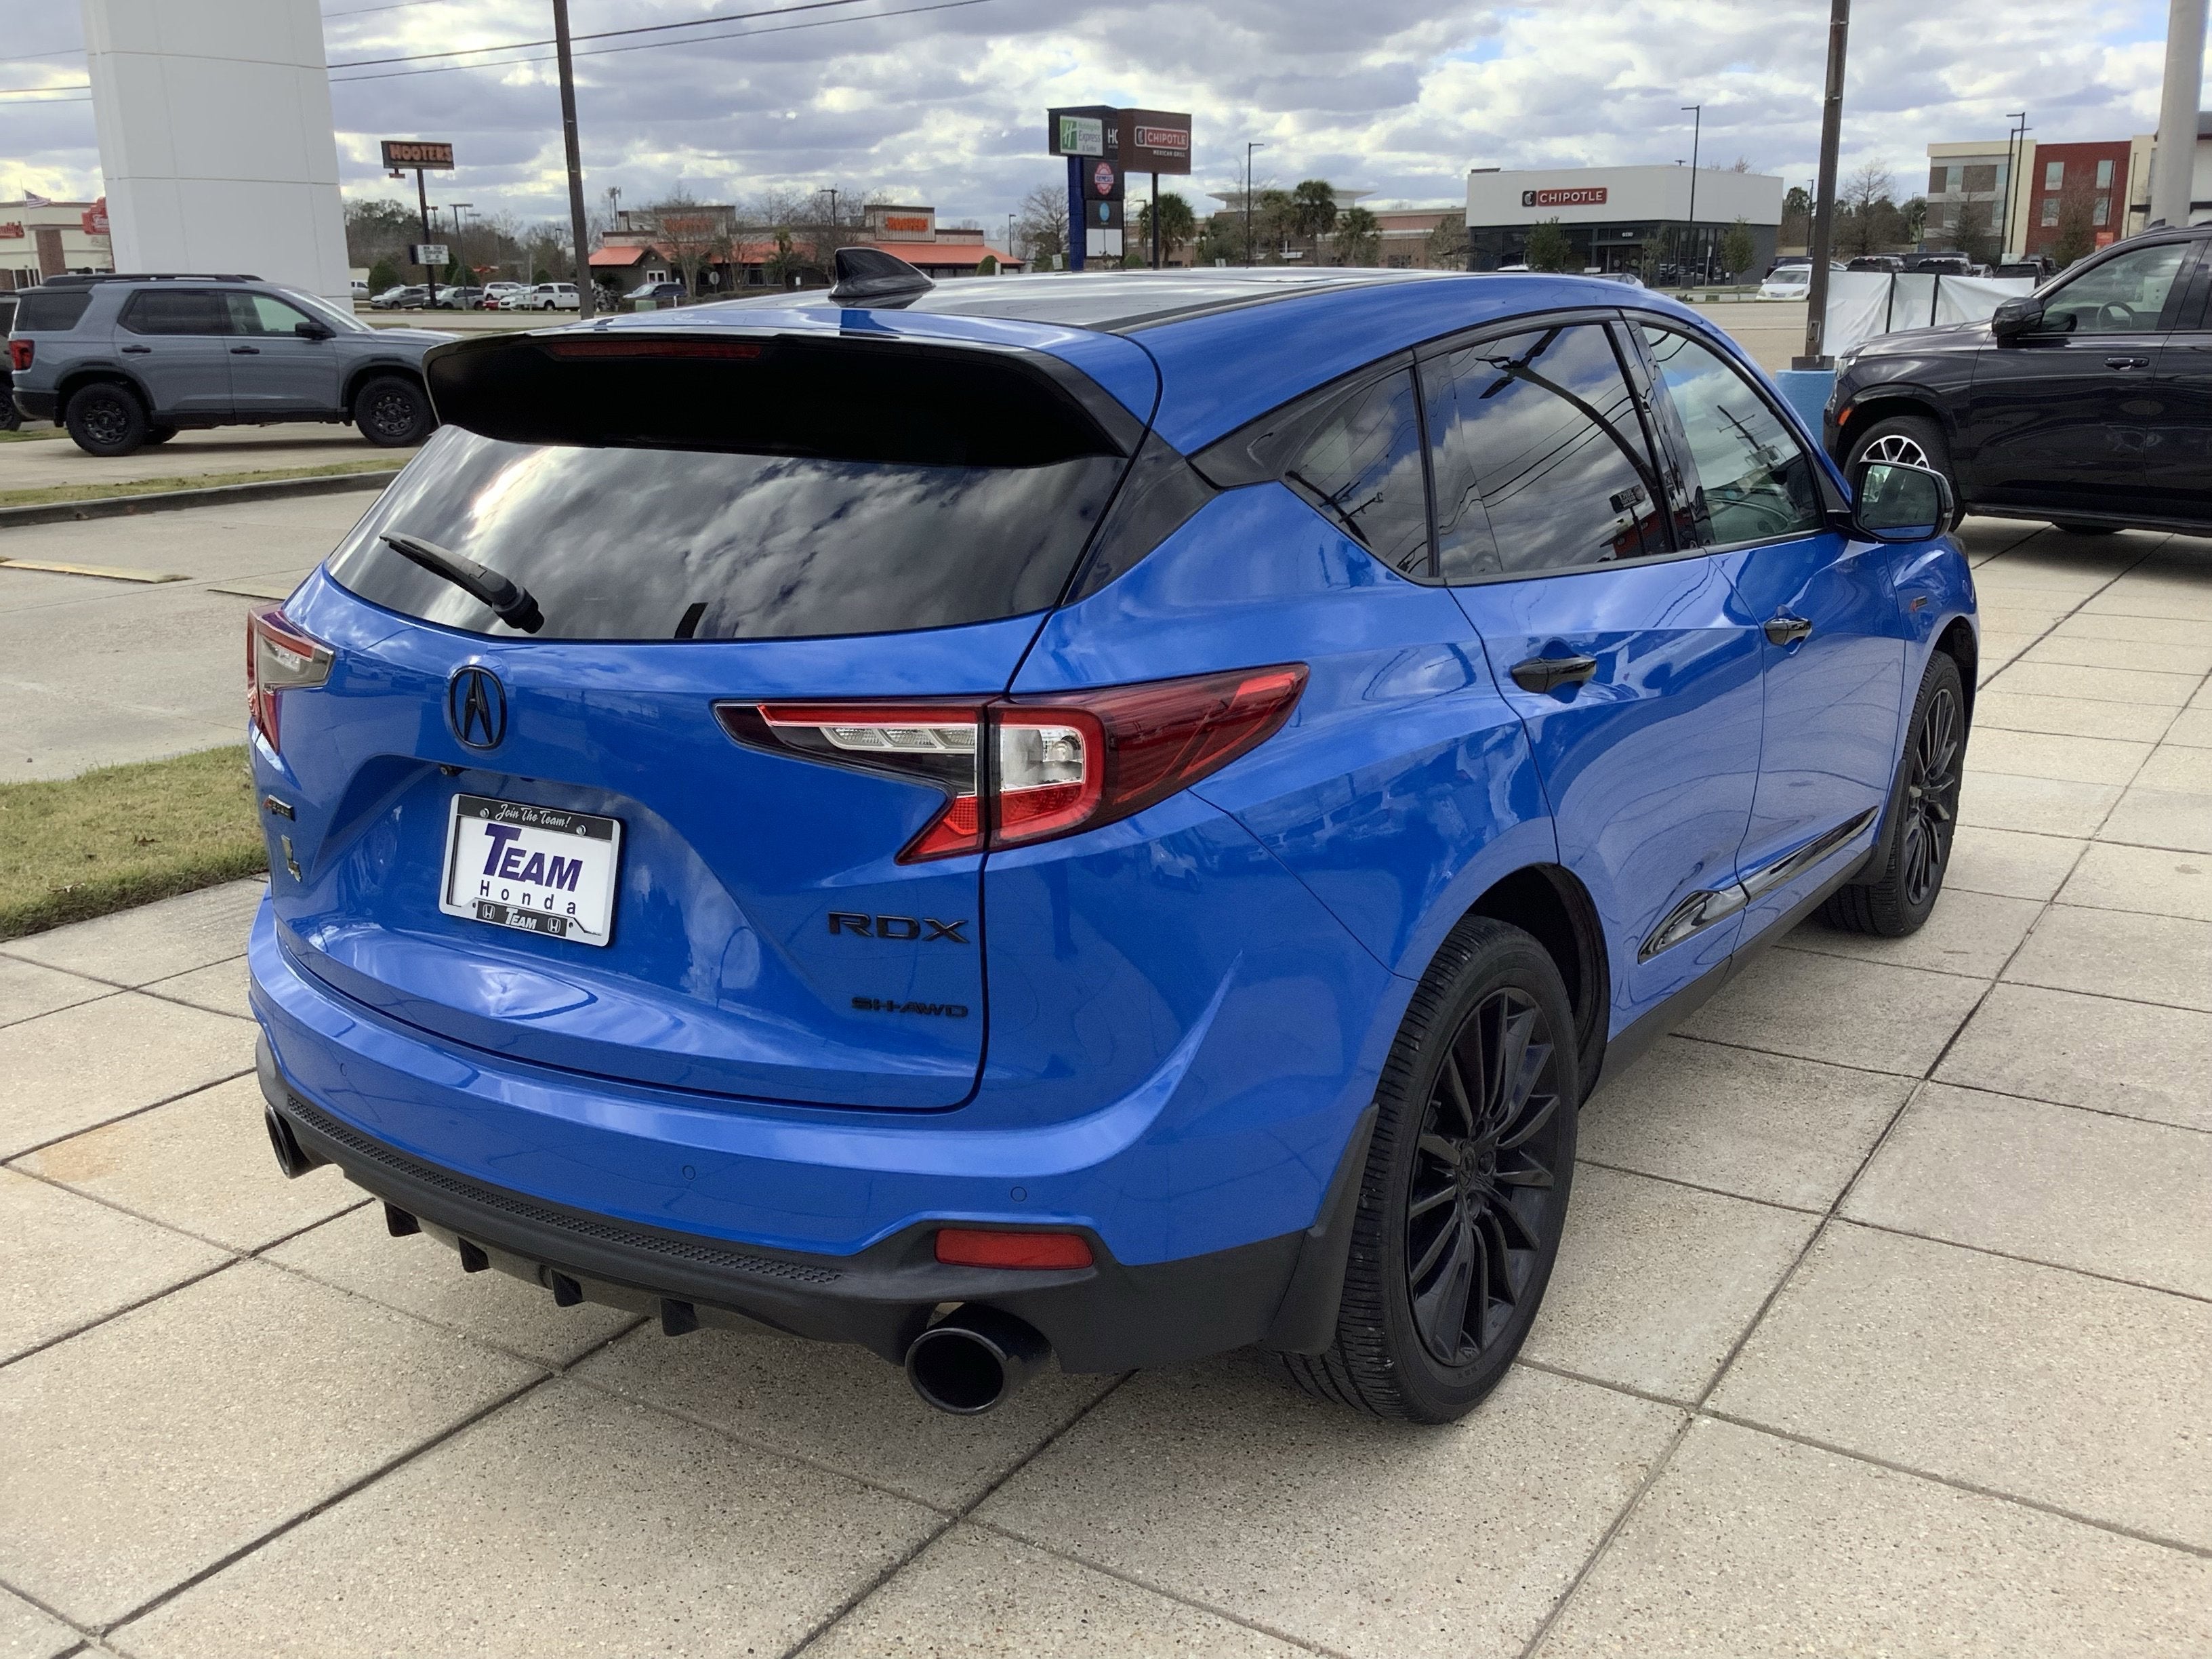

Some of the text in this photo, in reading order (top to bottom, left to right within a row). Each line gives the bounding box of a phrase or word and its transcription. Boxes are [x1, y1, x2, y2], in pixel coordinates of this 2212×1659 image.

[1078, 130, 1101, 144] Express
[1147, 132, 1186, 145] CHIPOTLE
[389, 144, 453, 162] HOOTERS
[1539, 190, 1603, 203] CHIPOTLE
[495, 804, 571, 827] Join The Team!
[483, 823, 583, 892] TEAM
[479, 880, 576, 915] Honda
[505, 907, 537, 930] TEAM
[828, 911, 970, 944] RDX
[851, 996, 969, 1019] SH-AWD
